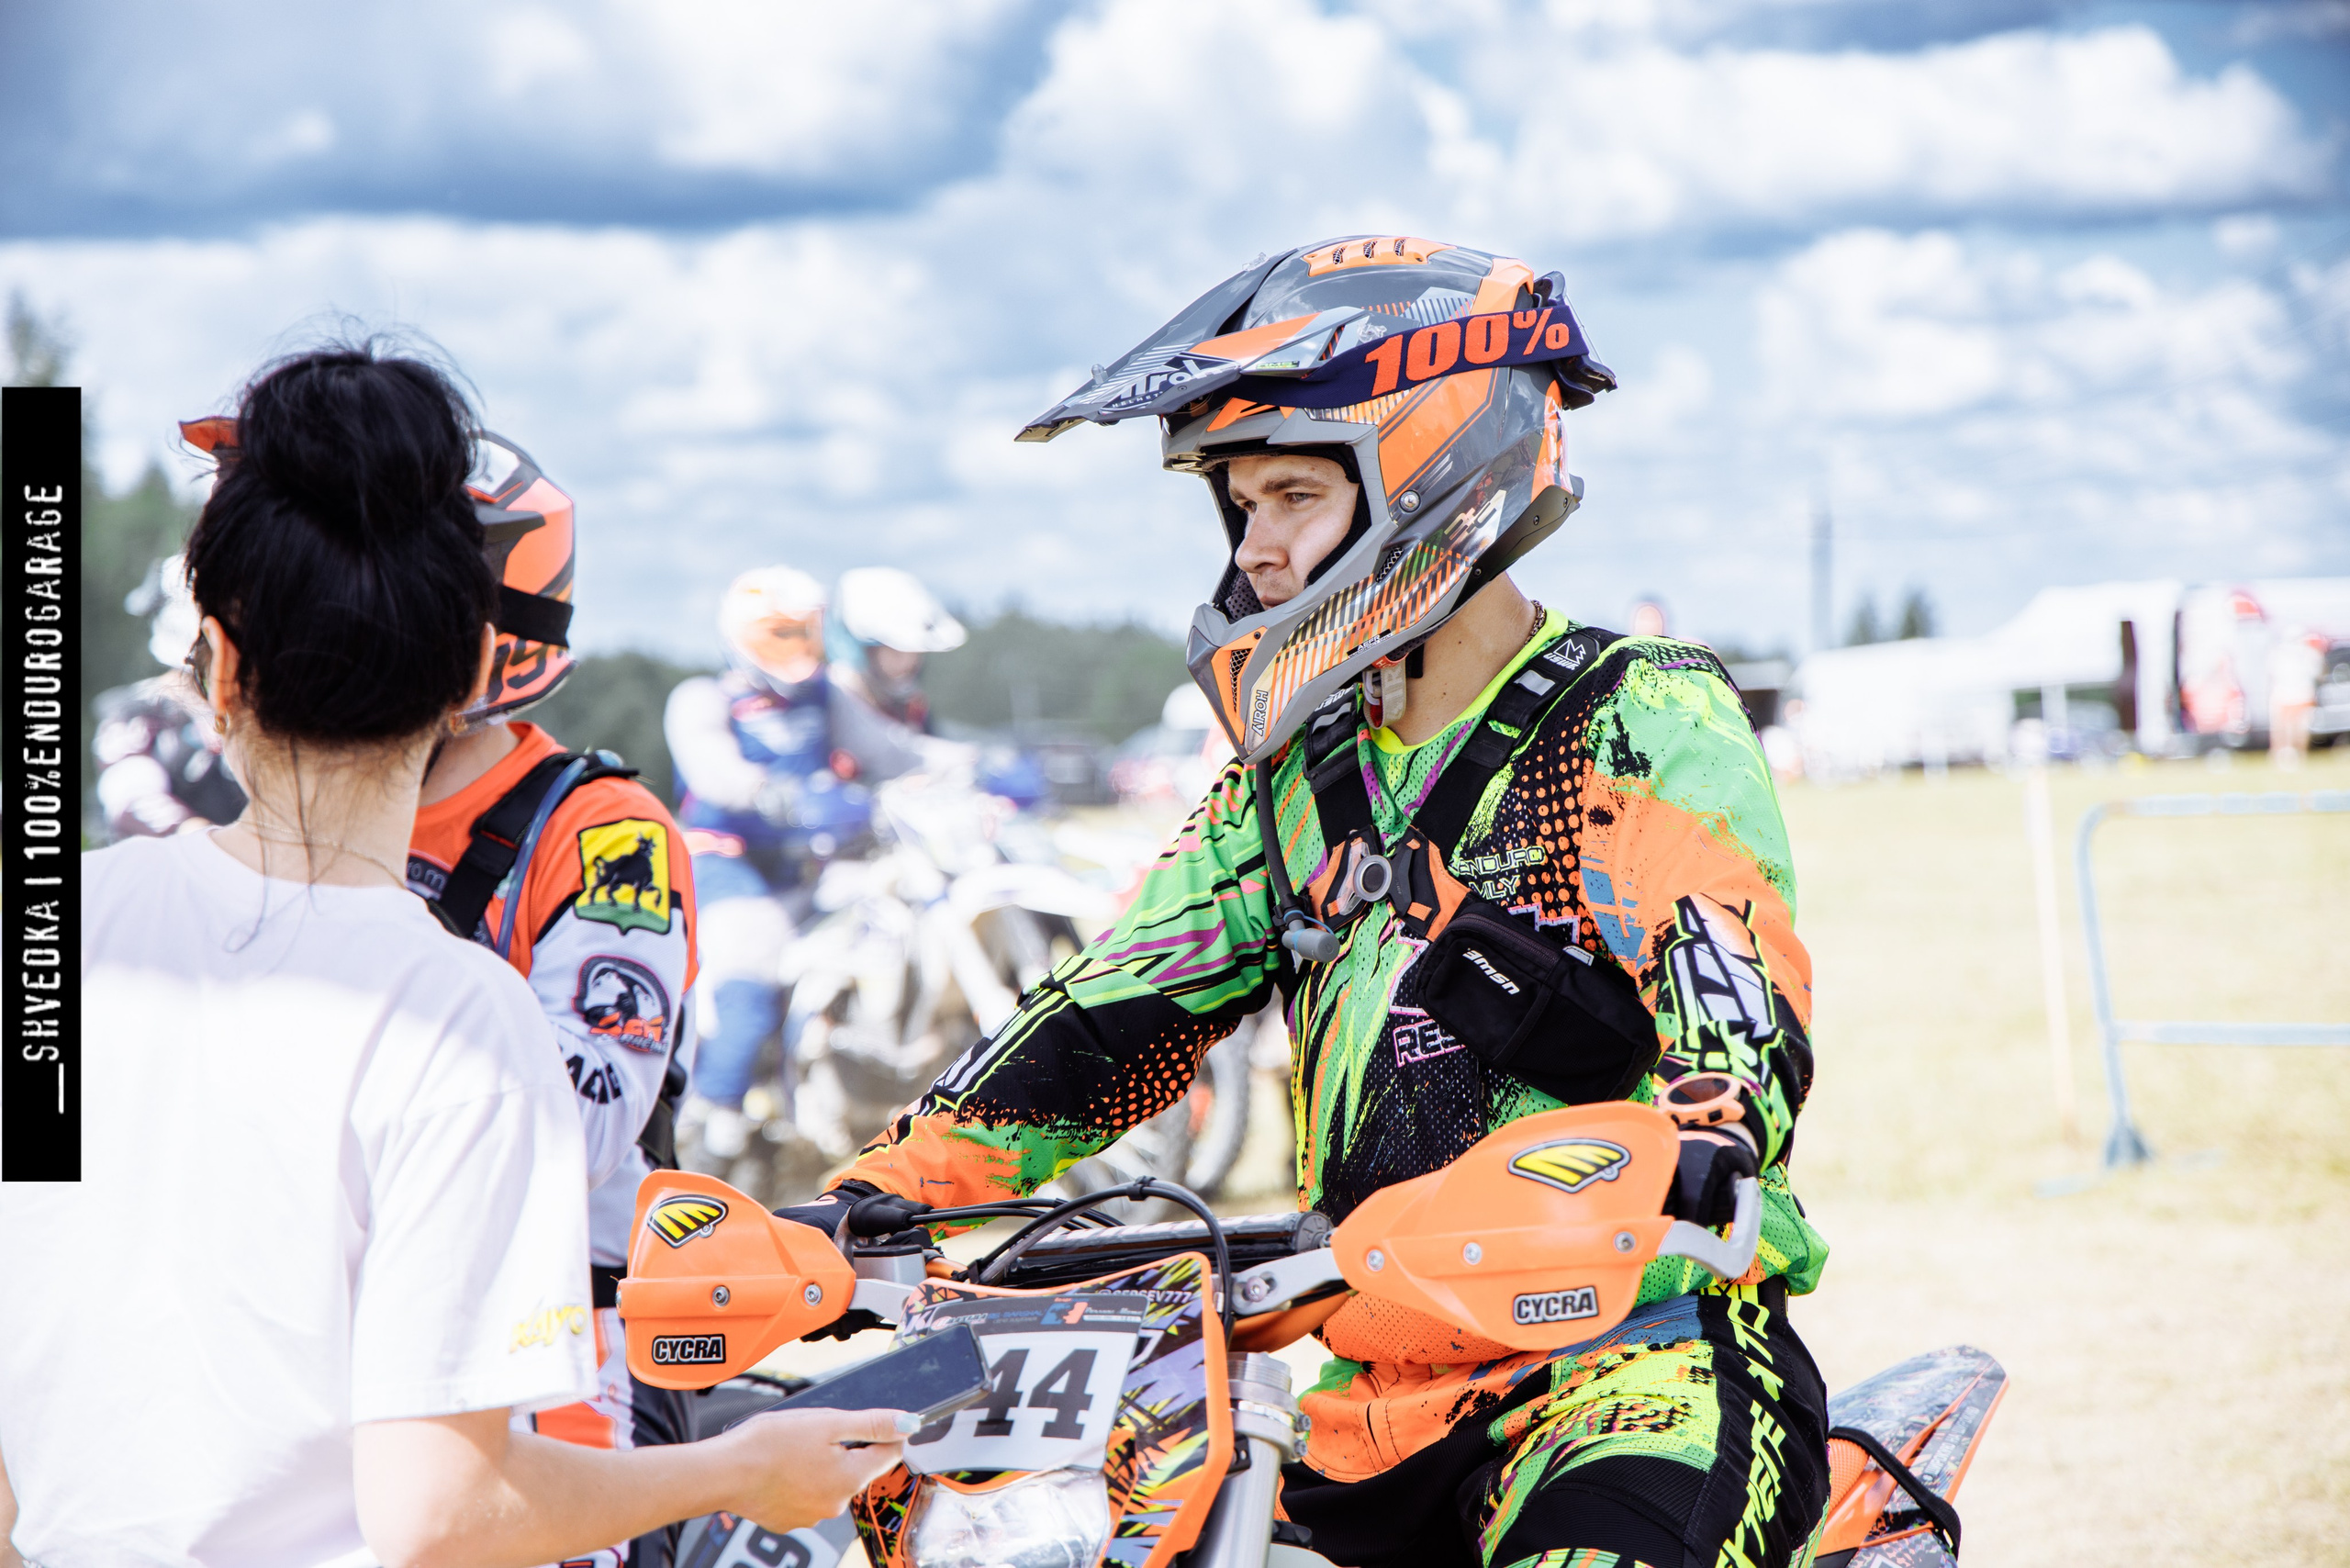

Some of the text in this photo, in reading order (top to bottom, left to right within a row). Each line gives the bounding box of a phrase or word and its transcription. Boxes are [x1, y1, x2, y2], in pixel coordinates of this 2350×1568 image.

[1364, 307, 1570, 397] 100%
[1251, 689, 1269, 737] AIROH
[1515, 1287, 1596, 1322] CYCRA
[653, 1337, 723, 1363] CYCRA
[907, 1348, 1099, 1447] 44
